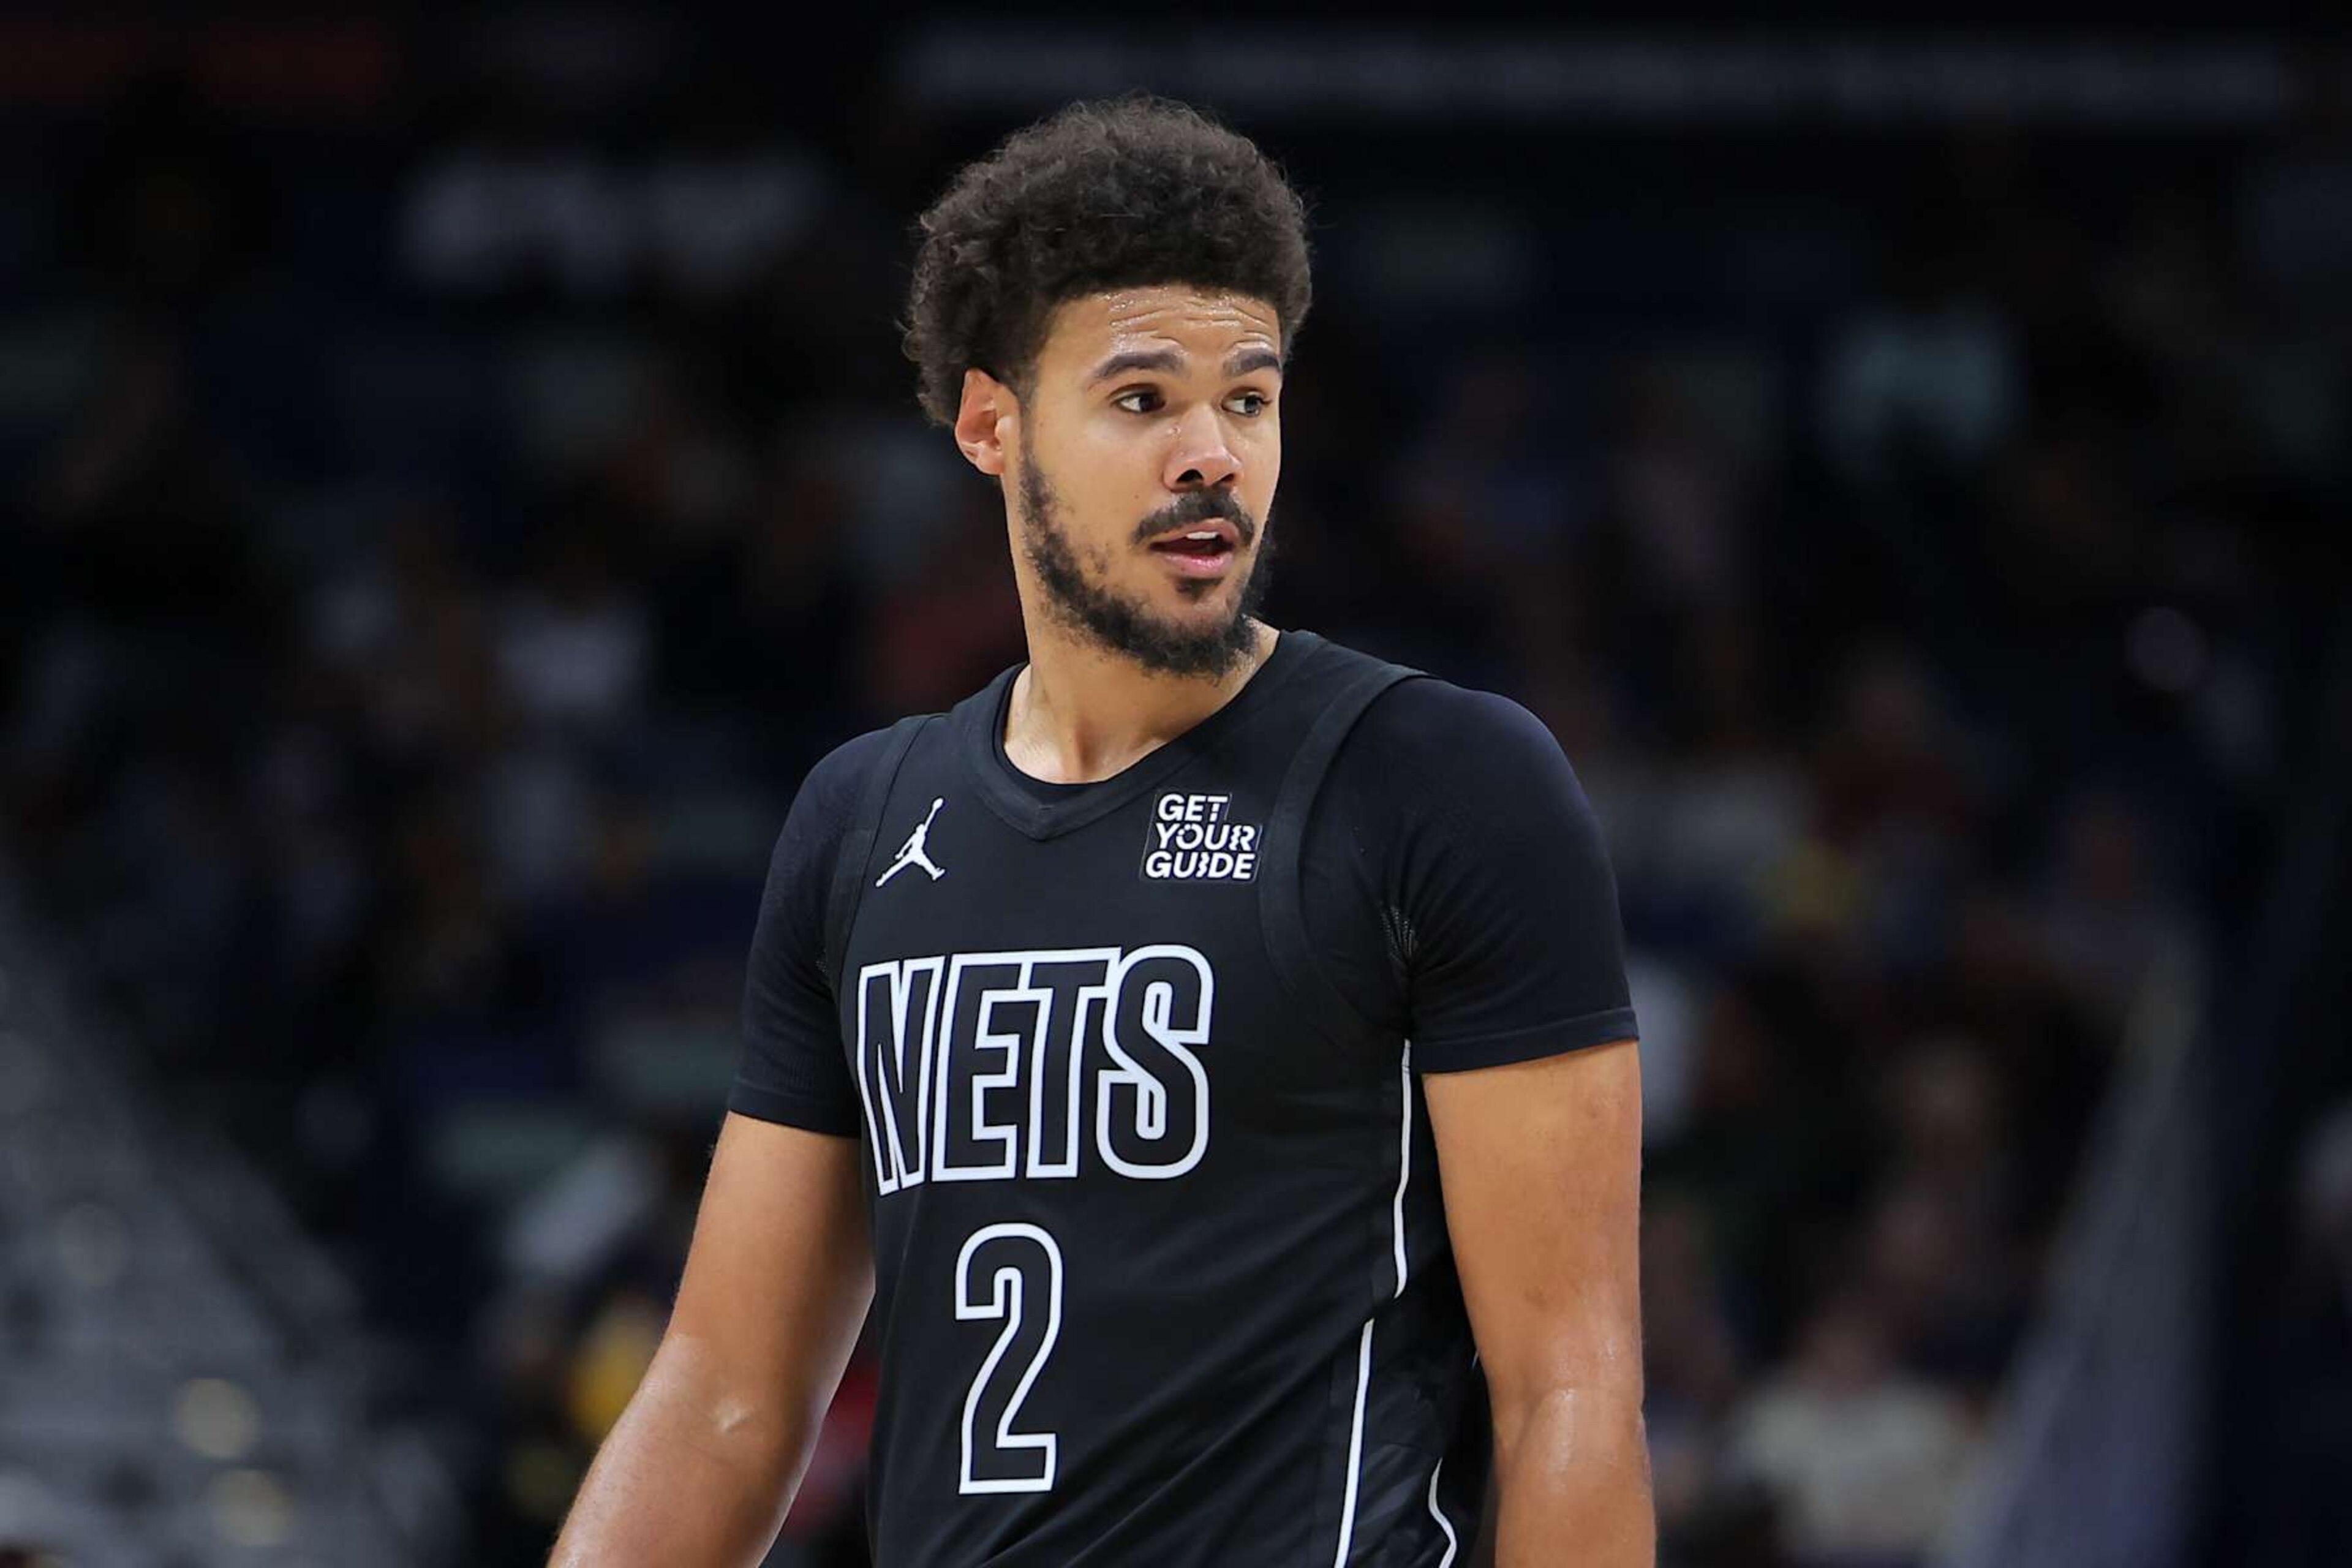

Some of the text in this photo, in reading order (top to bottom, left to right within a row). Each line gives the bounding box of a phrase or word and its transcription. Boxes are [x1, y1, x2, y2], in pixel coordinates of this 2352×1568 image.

[1157, 793, 1229, 822] GET
[1155, 823, 1256, 851] YOUR
[1145, 850, 1256, 880] GUIDE
[857, 944, 1215, 1196] NETS
[955, 1222, 1064, 1494] 2
